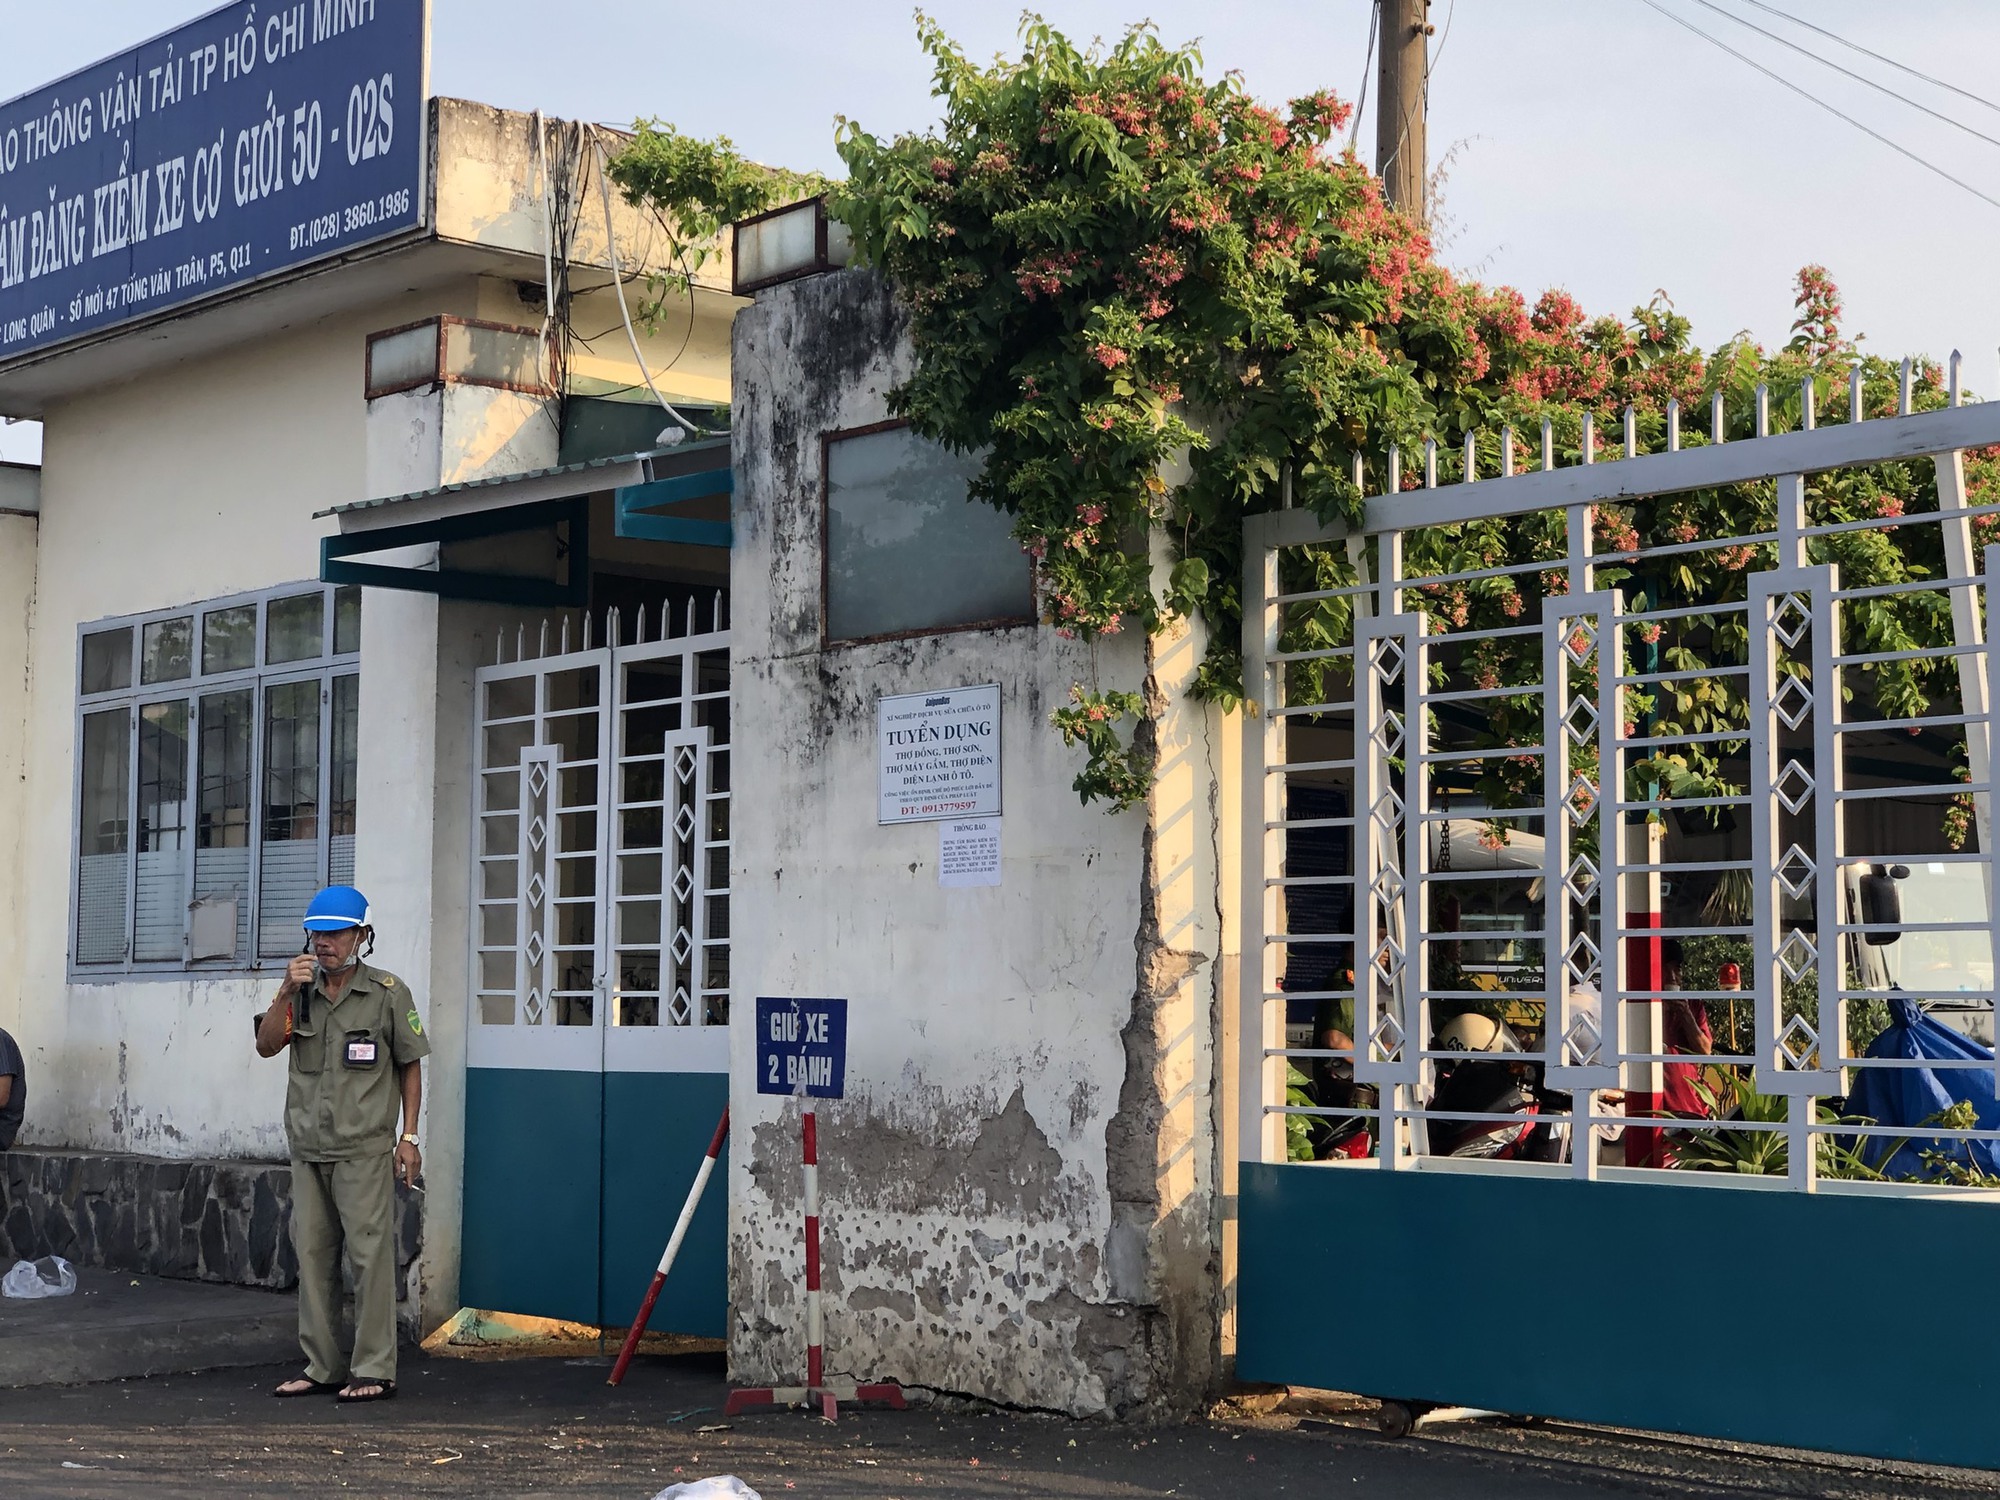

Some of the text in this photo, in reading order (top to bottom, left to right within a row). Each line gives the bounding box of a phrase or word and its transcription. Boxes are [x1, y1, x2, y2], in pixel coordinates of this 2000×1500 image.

[24, 98, 92, 163] THÔNG
[100, 72, 142, 138] VẬN
[149, 42, 183, 112] TẢI
[190, 44, 217, 95] TP
[224, 4, 257, 82] HỒ
[30, 184, 85, 279] ĐĂNG
[92, 139, 149, 259] KIỂM
[154, 156, 185, 236] XE
[193, 128, 225, 223] CƠ
[234, 90, 285, 207] GIỚI
[292, 100, 322, 186] 50
[347, 73, 393, 166] 02S
[4, 317, 26, 344] LONG
[30, 304, 55, 339] QUÂN
[69, 289, 83, 323] SỐ
[84, 284, 104, 318] MỚI
[106, 286, 119, 311] 47
[121, 272, 149, 306] TỐNG
[150, 267, 172, 297] VĂN
[176, 255, 207, 289] TRÂN,
[210, 251, 227, 278] P5,
[230, 242, 251, 273] Q11
[290, 211, 340, 251] ĐT.(028)
[343, 188, 410, 233] 3860.1986
[886, 719, 992, 746] TUYỂN DỤNG
[886, 764, 903, 775] THỢ
[904, 761, 924, 773] MÁY
[950, 757, 969, 768] THỢ
[970, 755, 993, 766] ĐIỆN
[895, 751, 913, 761] THỢ
[943, 745, 961, 756] THỢ
[925, 772, 949, 784] LẠNH
[901, 801, 976, 816] ĐT: 0913779597
[805, 1012, 829, 1043] XE
[768, 1045, 833, 1087] 2 BÁNH
